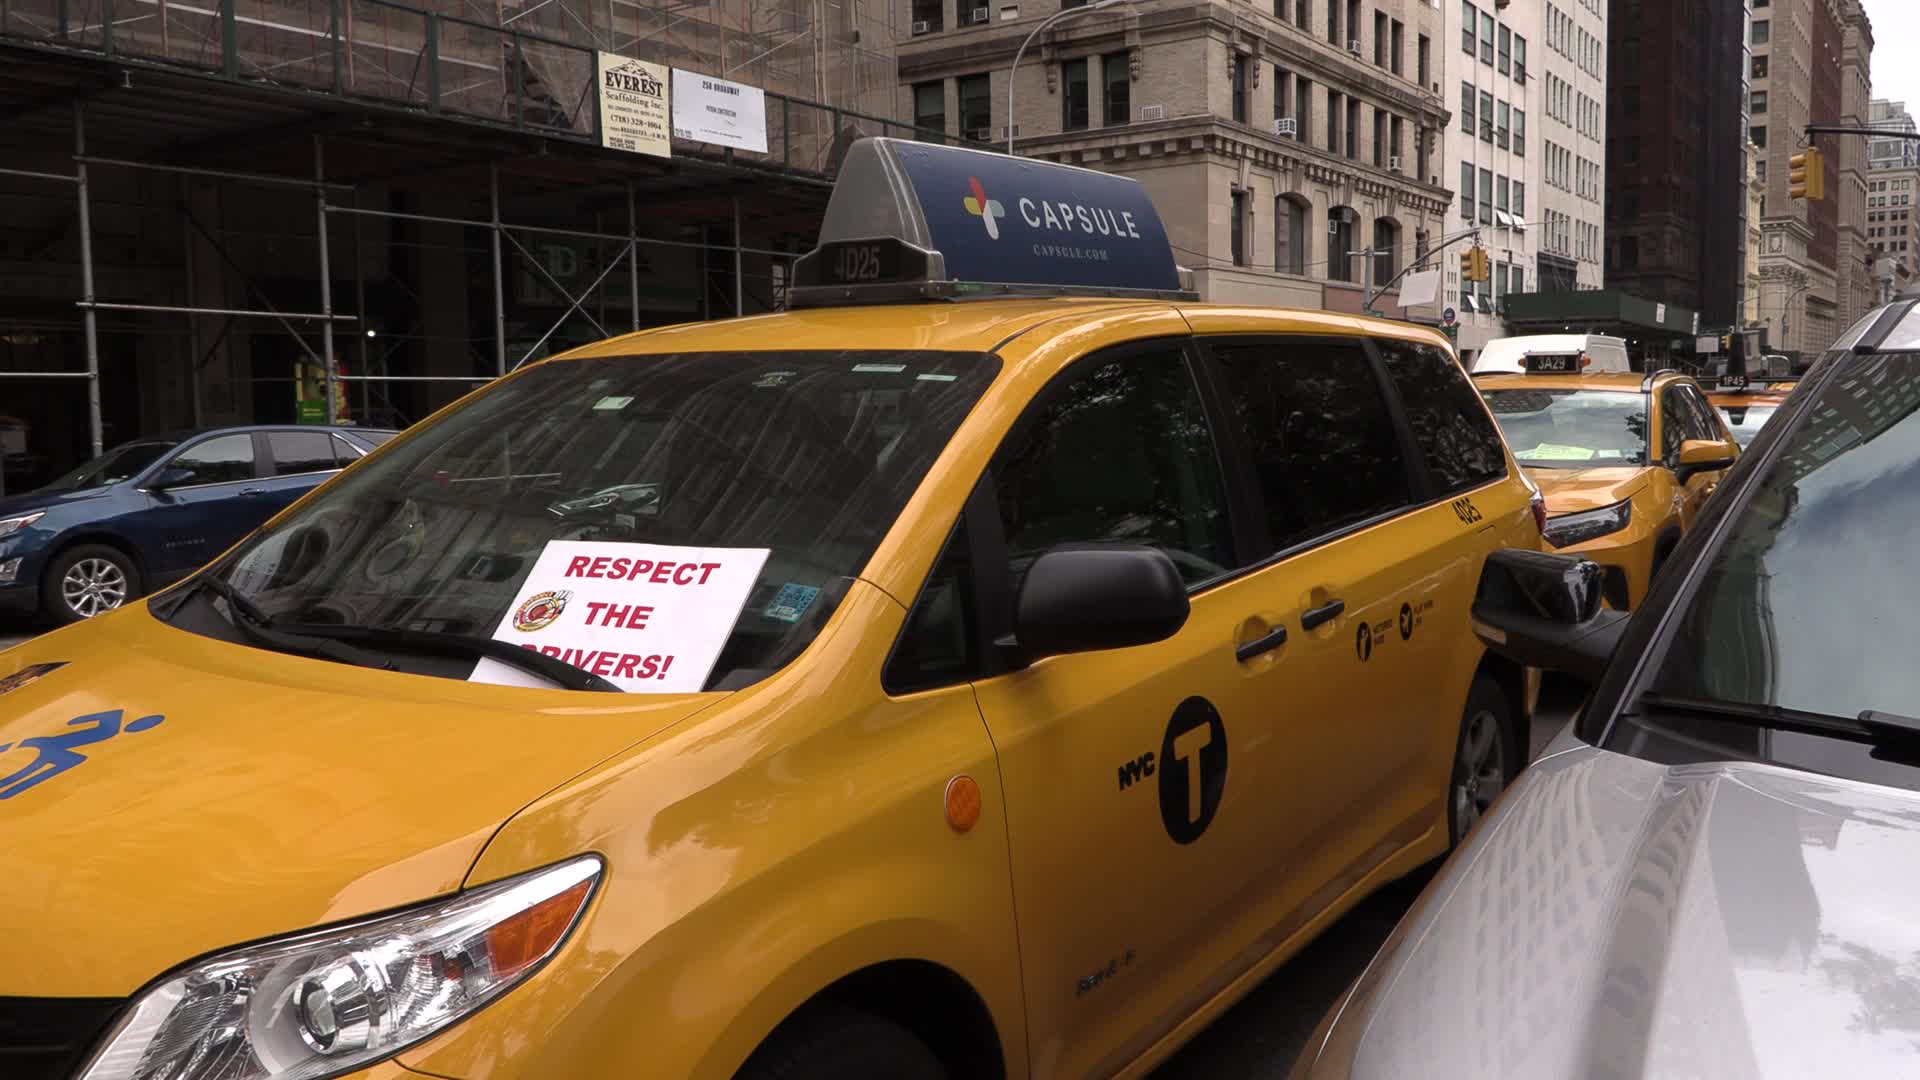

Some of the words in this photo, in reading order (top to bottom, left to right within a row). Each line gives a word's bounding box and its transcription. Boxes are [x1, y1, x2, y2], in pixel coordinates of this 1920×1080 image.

[605, 70, 663, 98] EVEREST
[605, 90, 649, 108] Scaffolding
[1018, 197, 1140, 239] CAPSULE
[1033, 243, 1109, 261] CAPSULE.COM
[1537, 356, 1566, 370] 3A29
[1723, 375, 1745, 386] 1P45
[564, 555, 721, 586] RESPECT
[585, 601, 655, 631] THE
[519, 643, 675, 681] IVERS!
[1118, 752, 1155, 792] NYC
[1174, 721, 1213, 825] T
